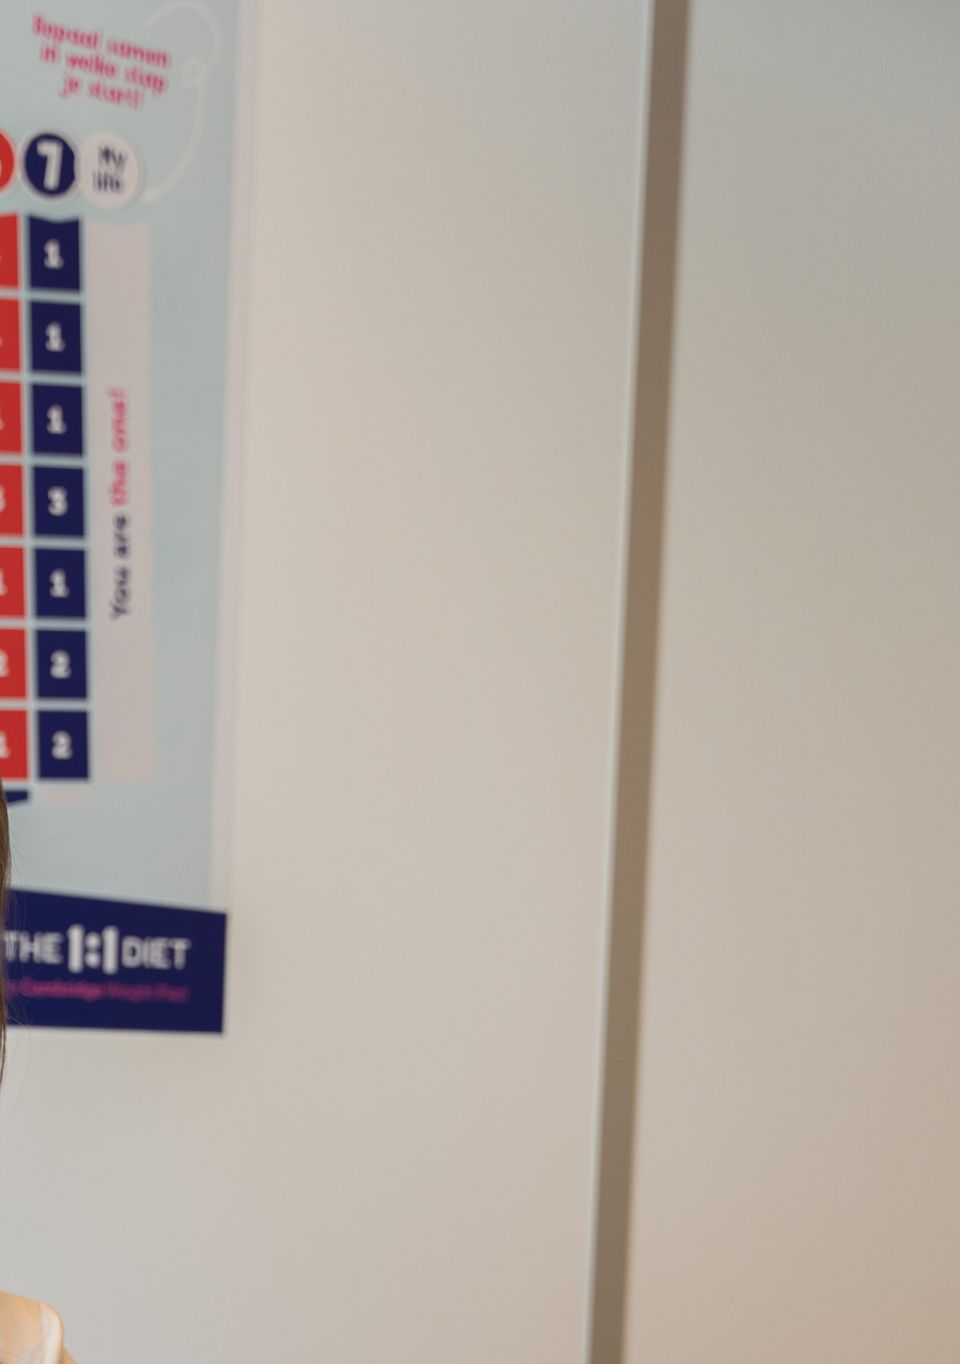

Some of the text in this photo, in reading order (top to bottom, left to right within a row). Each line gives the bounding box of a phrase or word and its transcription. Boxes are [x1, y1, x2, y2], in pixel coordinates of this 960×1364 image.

[37, 141, 62, 189] 7
[44, 241, 63, 269] 1
[46, 324, 64, 352] 1
[47, 406, 65, 434] 1
[107, 460, 129, 507] the
[48, 487, 67, 516] 3
[112, 514, 130, 560] are
[50, 570, 68, 598] 1
[109, 565, 130, 621] You
[50, 651, 70, 679] 2
[52, 731, 71, 759] 2
[4, 923, 192, 976] THE 1:1 DIET
